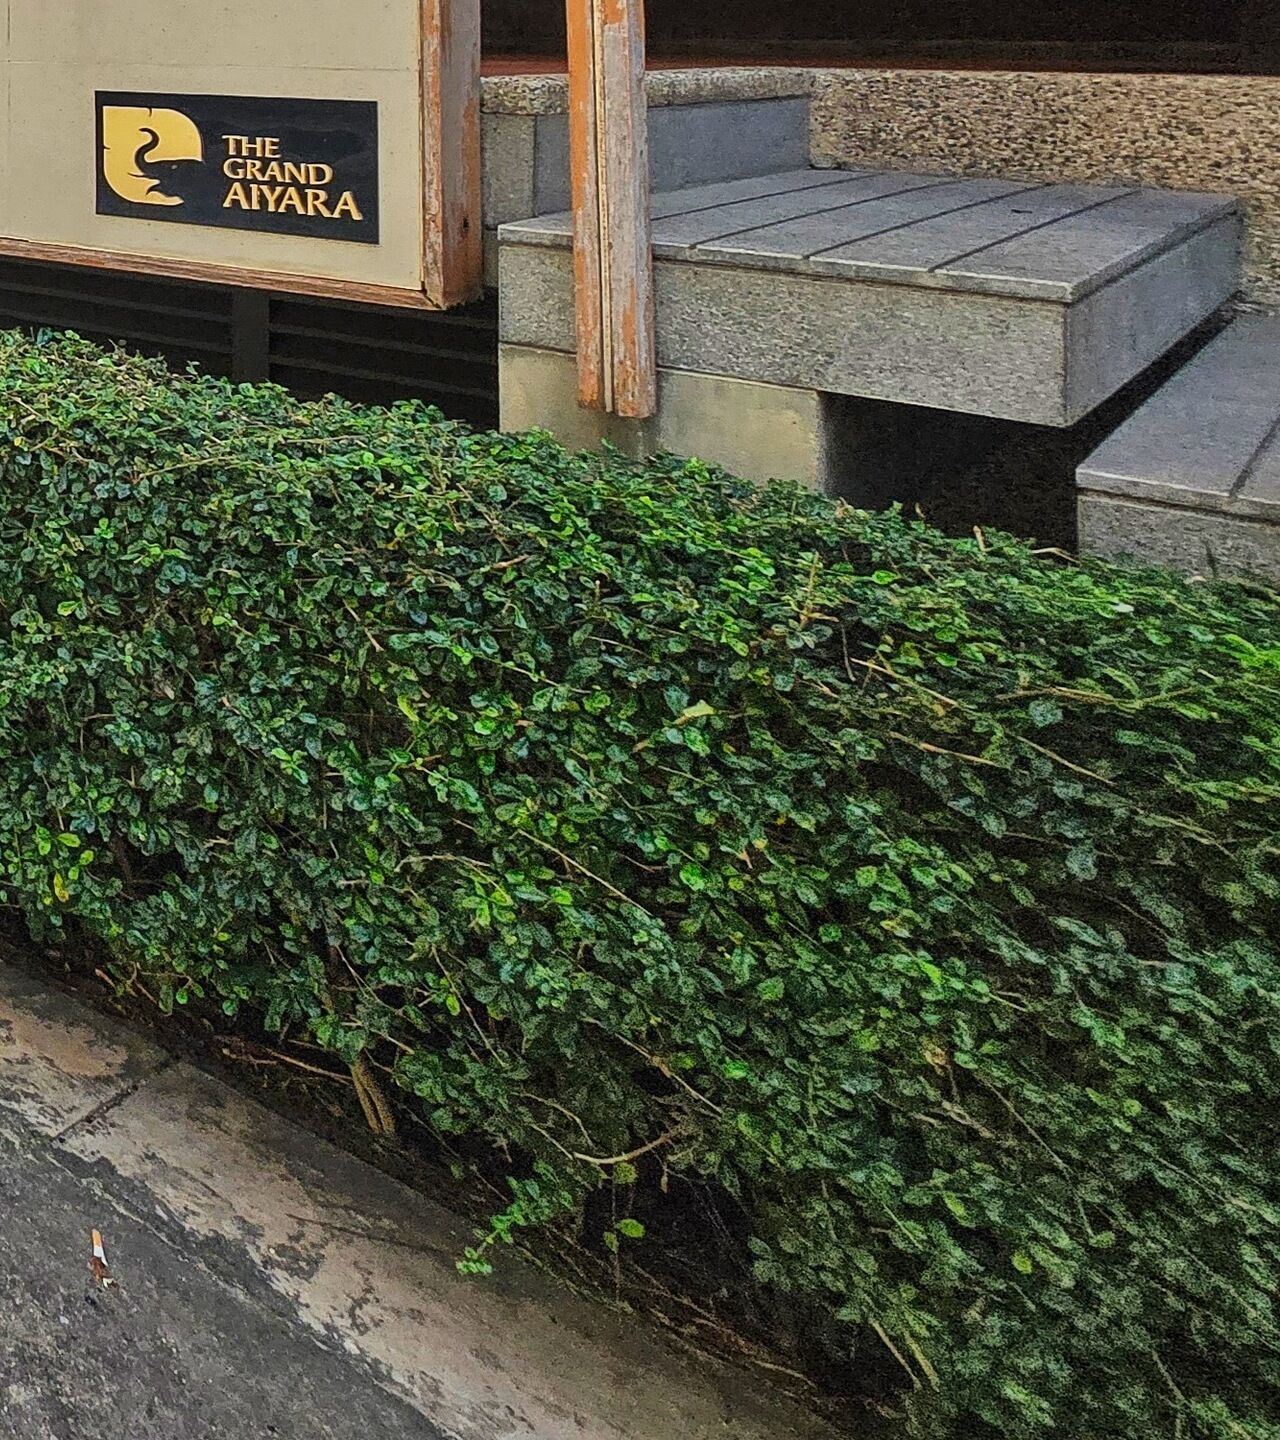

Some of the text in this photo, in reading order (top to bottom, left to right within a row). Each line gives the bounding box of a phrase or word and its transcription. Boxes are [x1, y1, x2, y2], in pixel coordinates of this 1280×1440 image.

[222, 134, 281, 159] THE
[222, 158, 334, 186] GRAND
[222, 181, 364, 222] AIYARA
